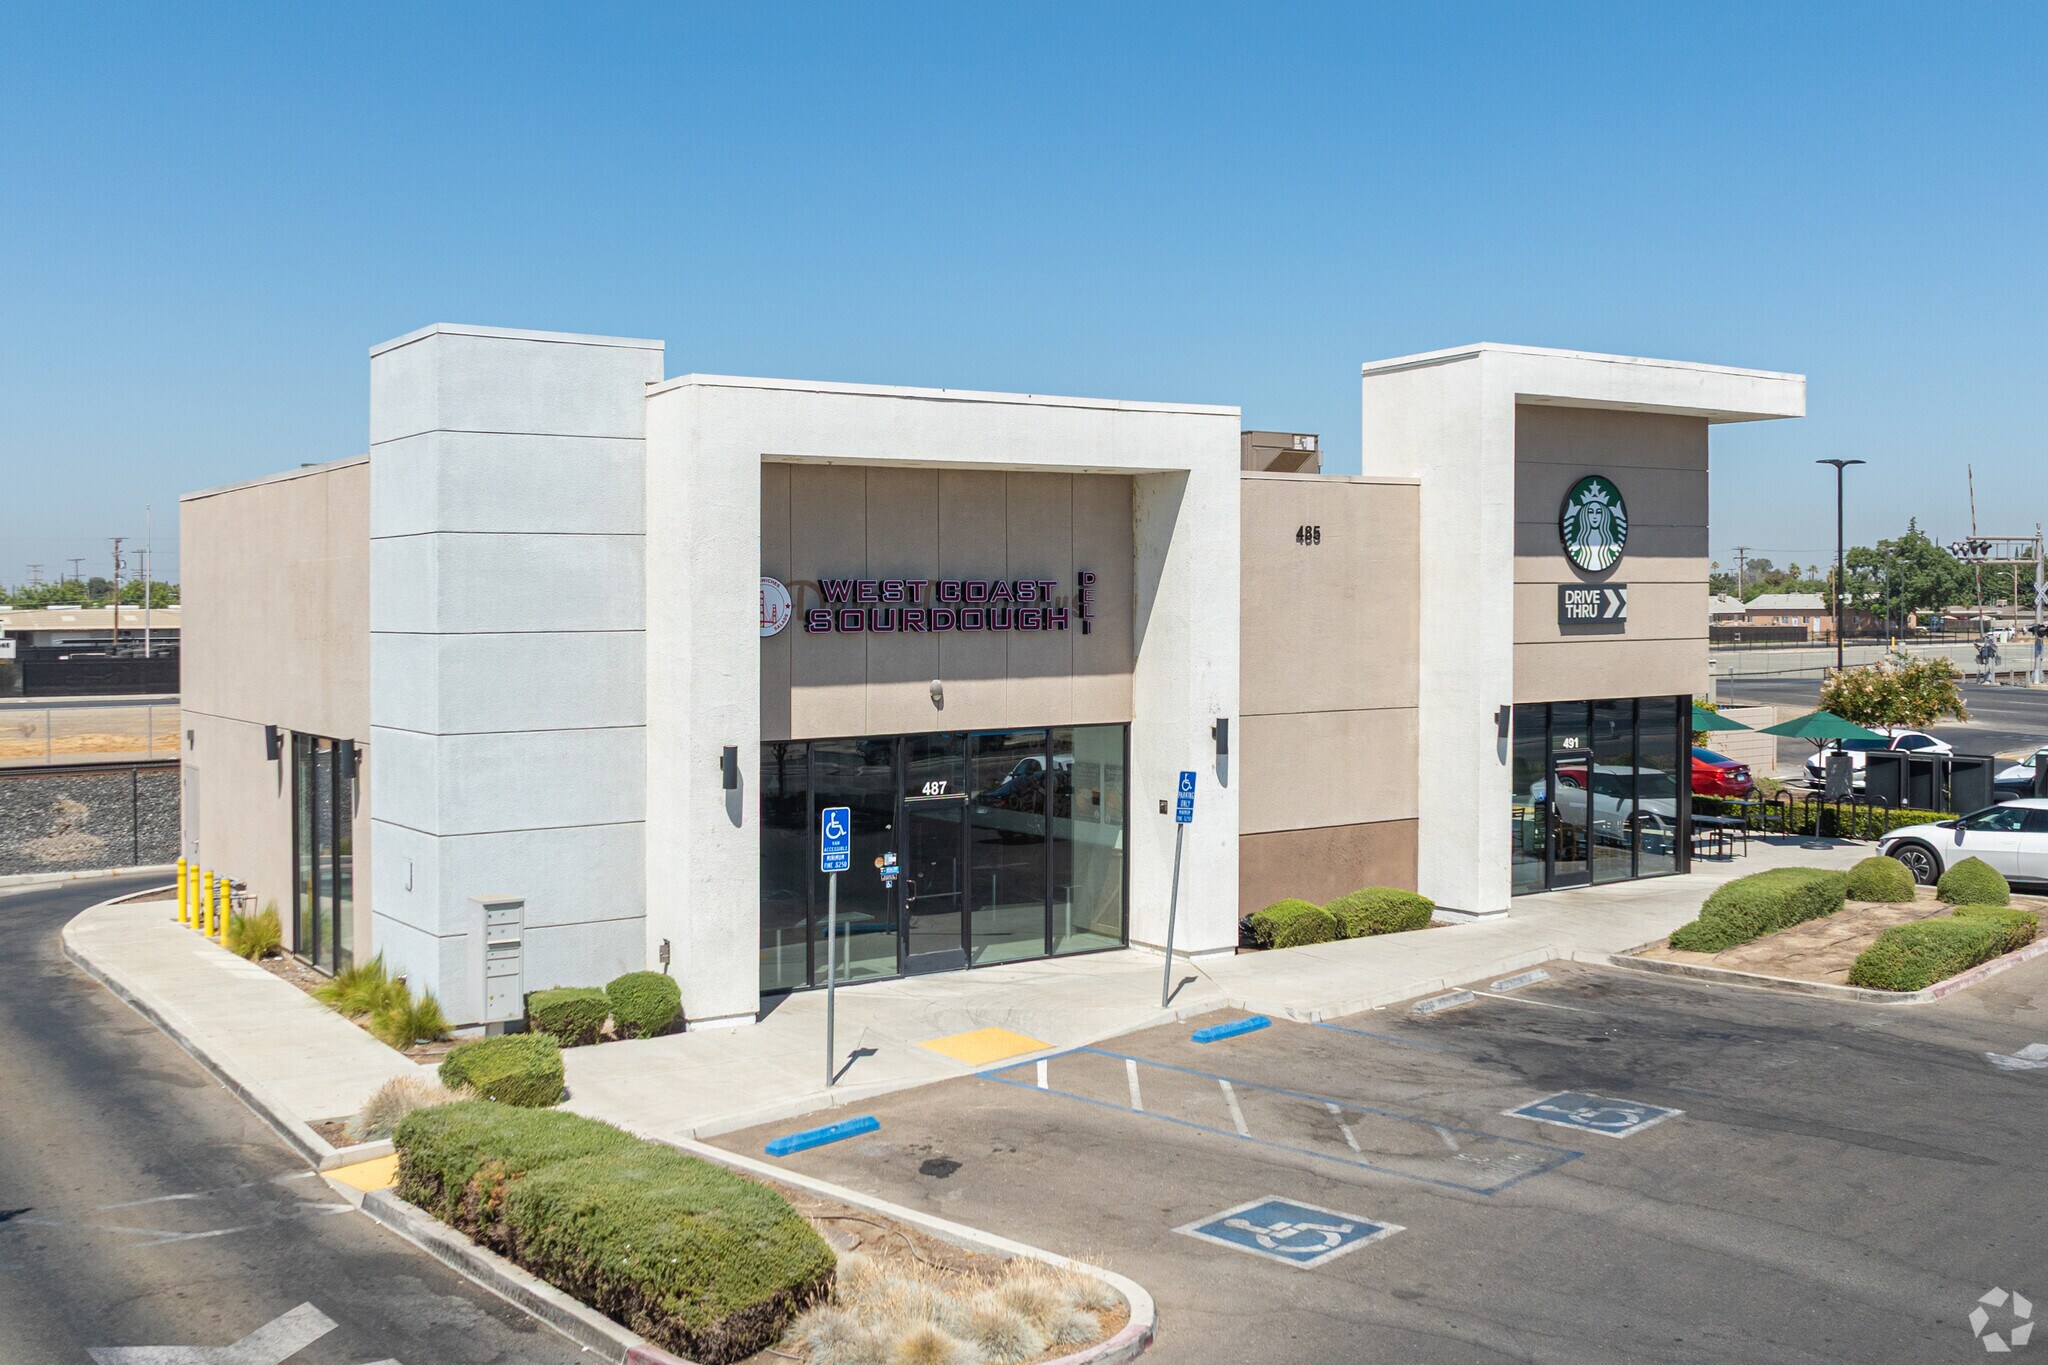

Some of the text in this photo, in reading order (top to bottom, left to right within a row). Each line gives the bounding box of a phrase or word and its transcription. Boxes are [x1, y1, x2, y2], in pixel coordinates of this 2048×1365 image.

[1296, 525, 1320, 540] 485
[820, 579, 928, 603] WEST
[938, 580, 1059, 603] COAST
[1565, 590, 1600, 604] DRIVE
[1081, 571, 1096, 635] DELI
[1565, 604, 1598, 618] THRU
[807, 607, 1070, 634] SOURDOUGH
[1563, 737, 1579, 749] 491
[922, 781, 948, 796] 487
